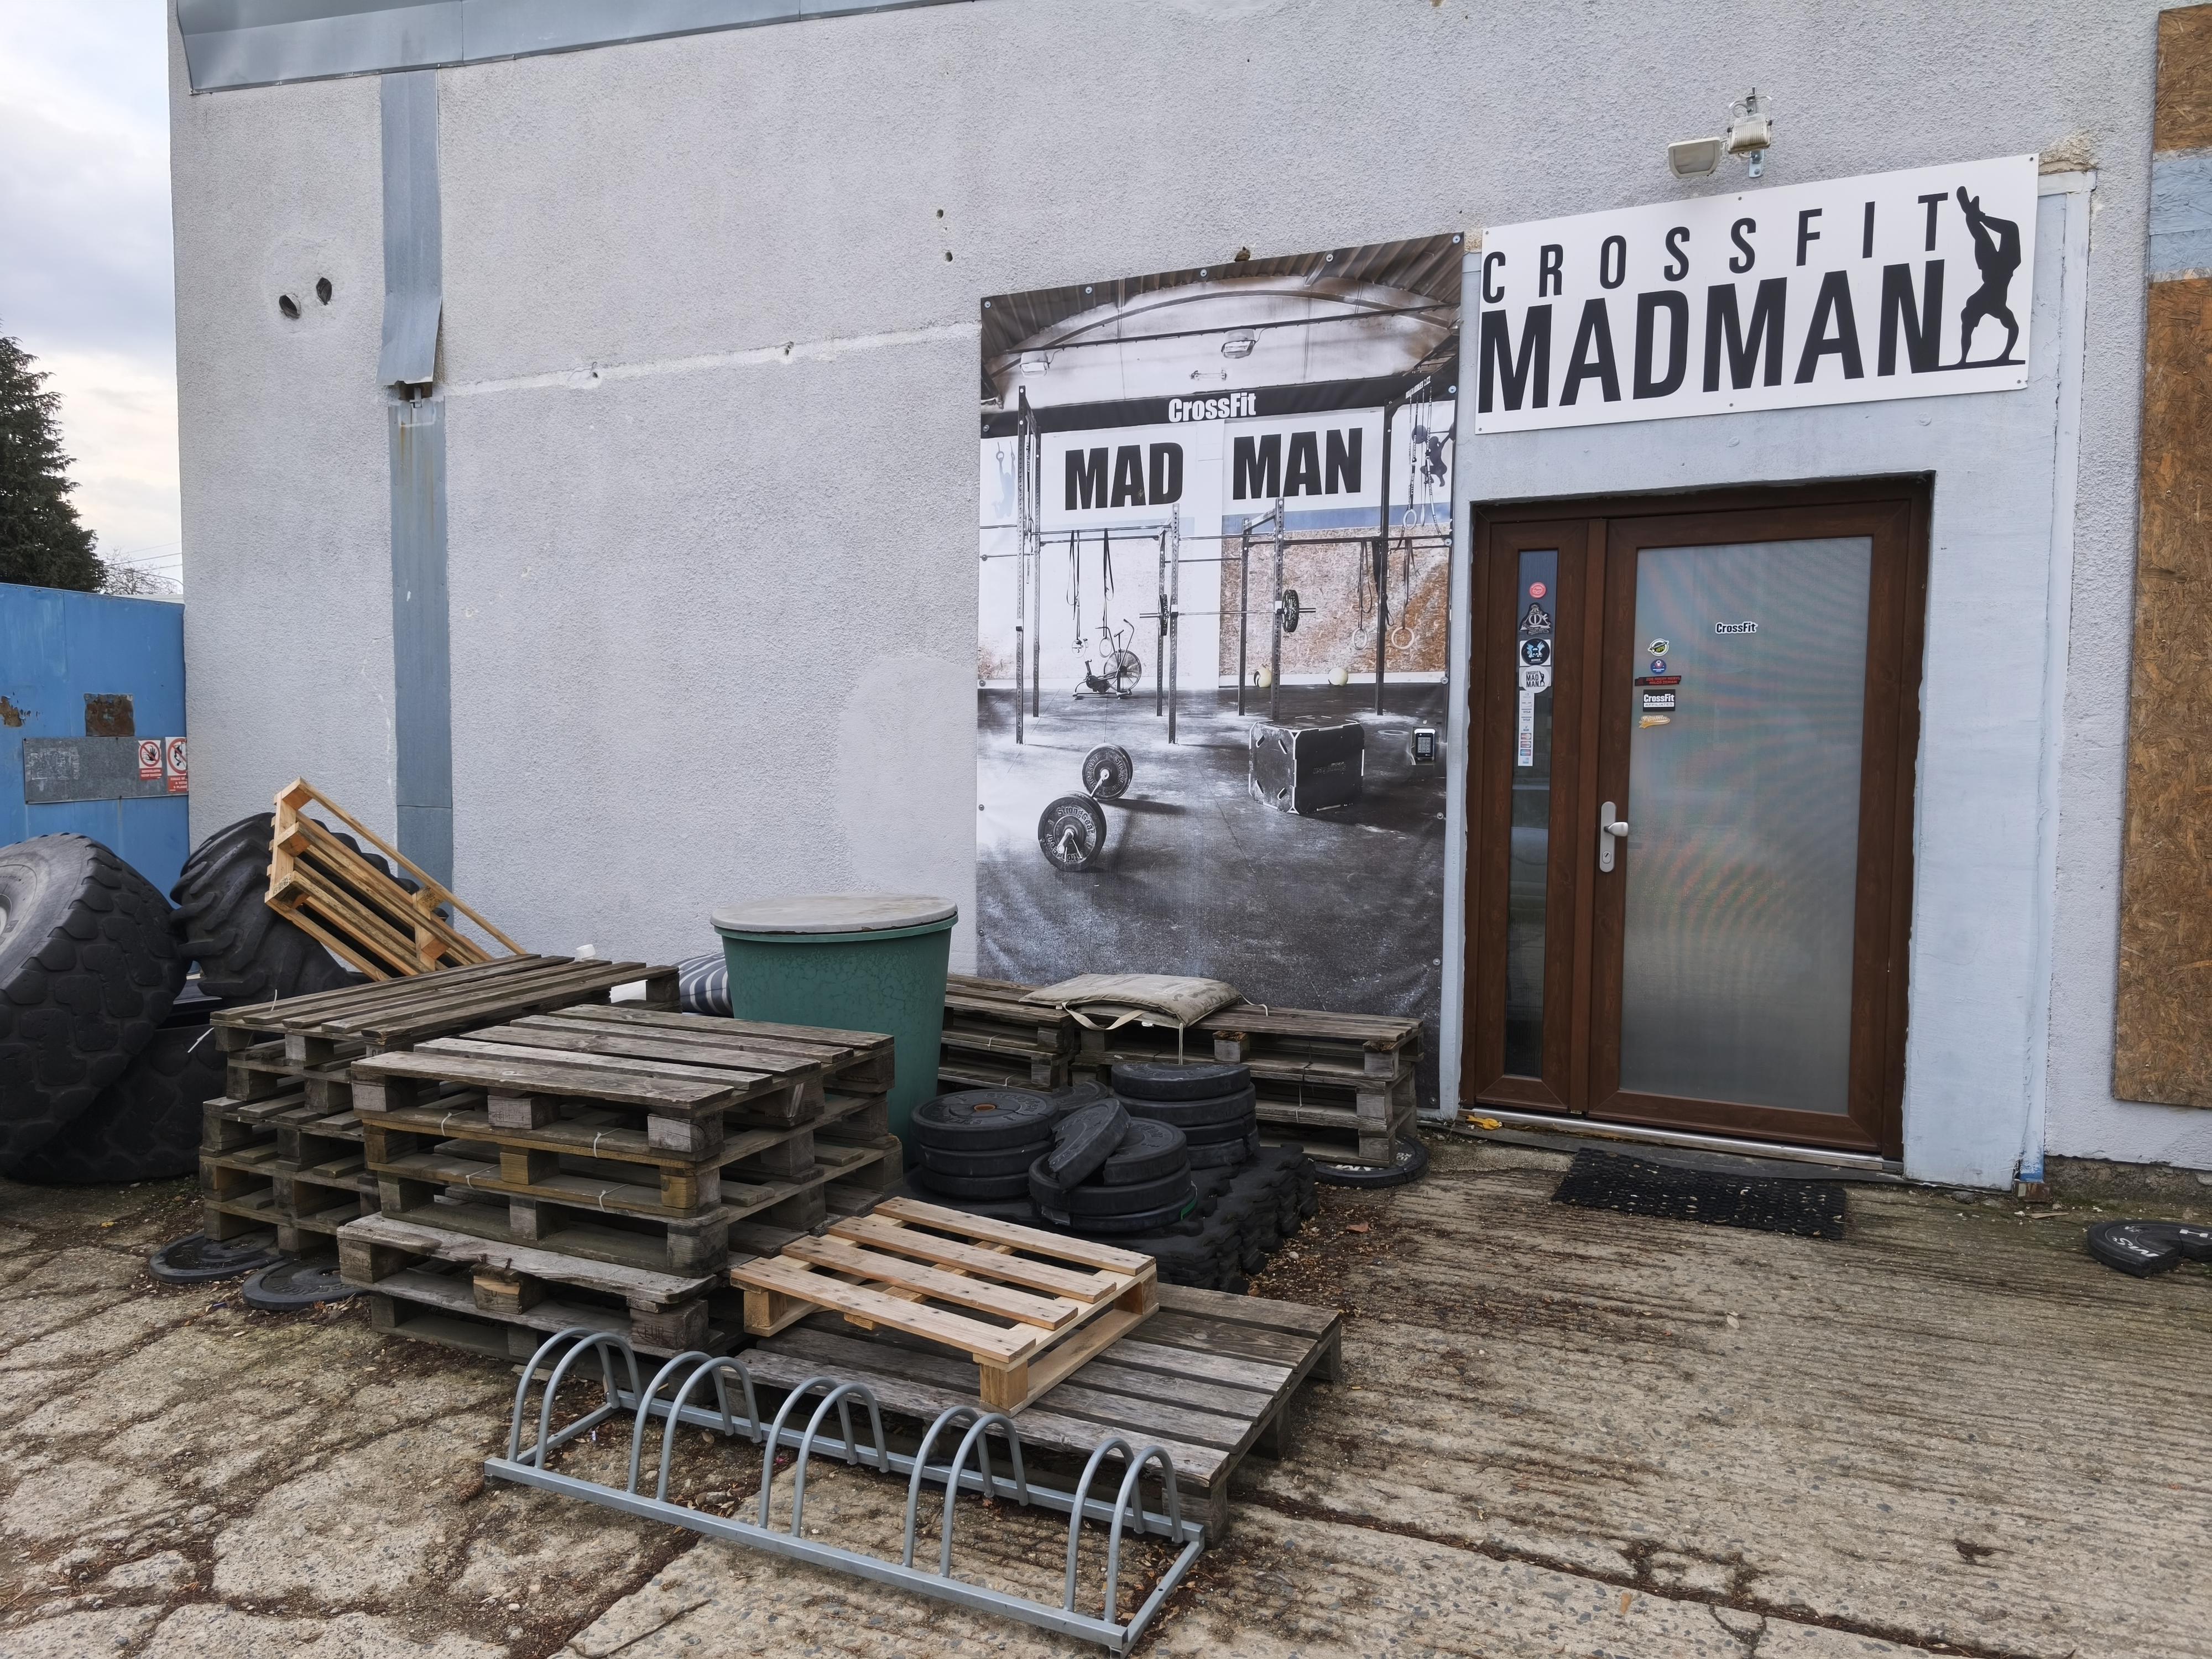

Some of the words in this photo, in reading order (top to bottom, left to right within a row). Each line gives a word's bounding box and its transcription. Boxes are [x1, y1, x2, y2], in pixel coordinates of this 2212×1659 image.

[1482, 192, 1949, 304] CROSSFIT
[1478, 258, 1945, 414] MADMAN
[1168, 392, 1257, 423] CrossFit
[1065, 442, 1183, 511] MAD
[1232, 427, 1363, 500] MAN
[1716, 622, 1756, 633] CrossFit
[1644, 693, 1675, 702] CrossFit
